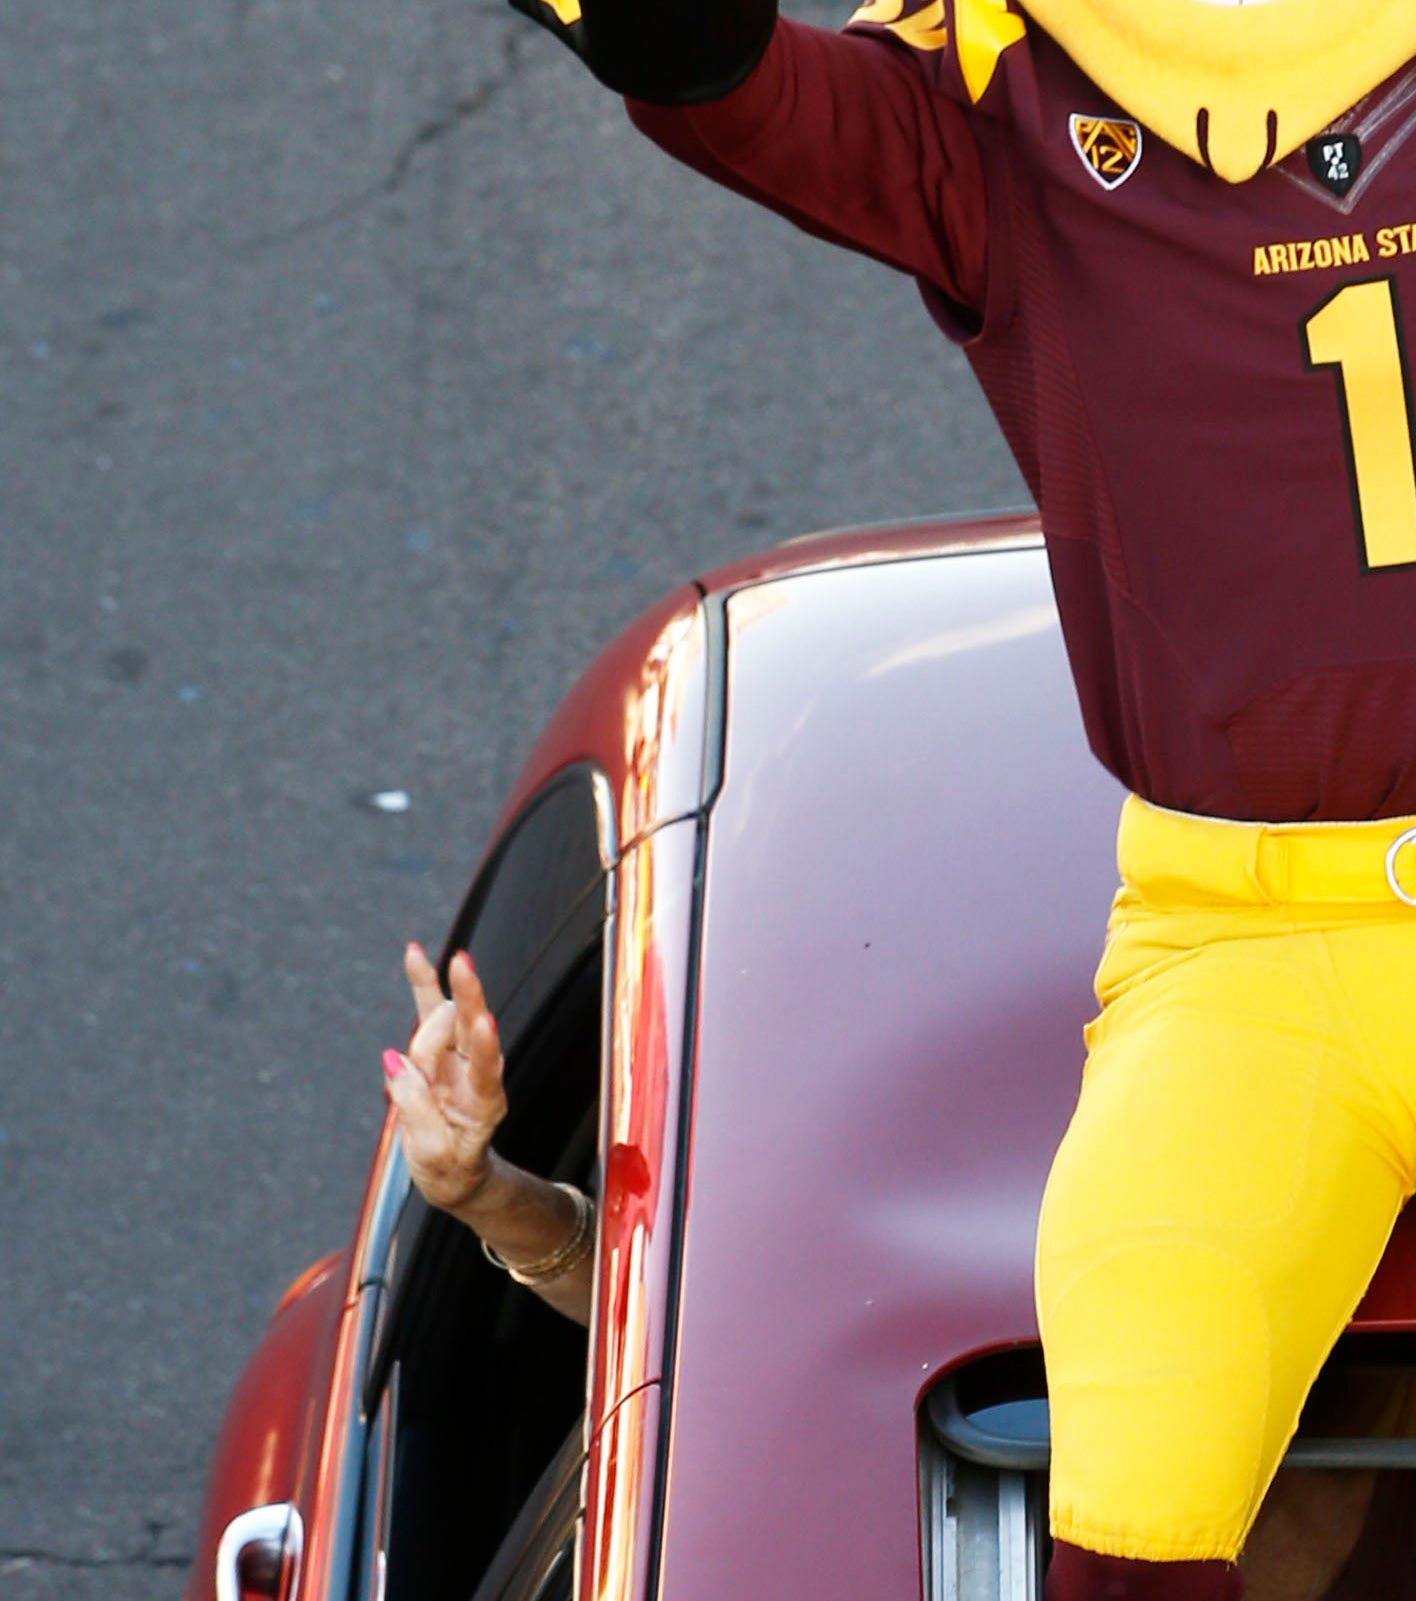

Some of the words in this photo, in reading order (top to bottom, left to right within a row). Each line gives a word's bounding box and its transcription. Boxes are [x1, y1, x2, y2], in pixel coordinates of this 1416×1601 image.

[1091, 144, 1124, 172] 12
[1323, 142, 1344, 162] PT
[1253, 233, 1370, 276] ARIZONA
